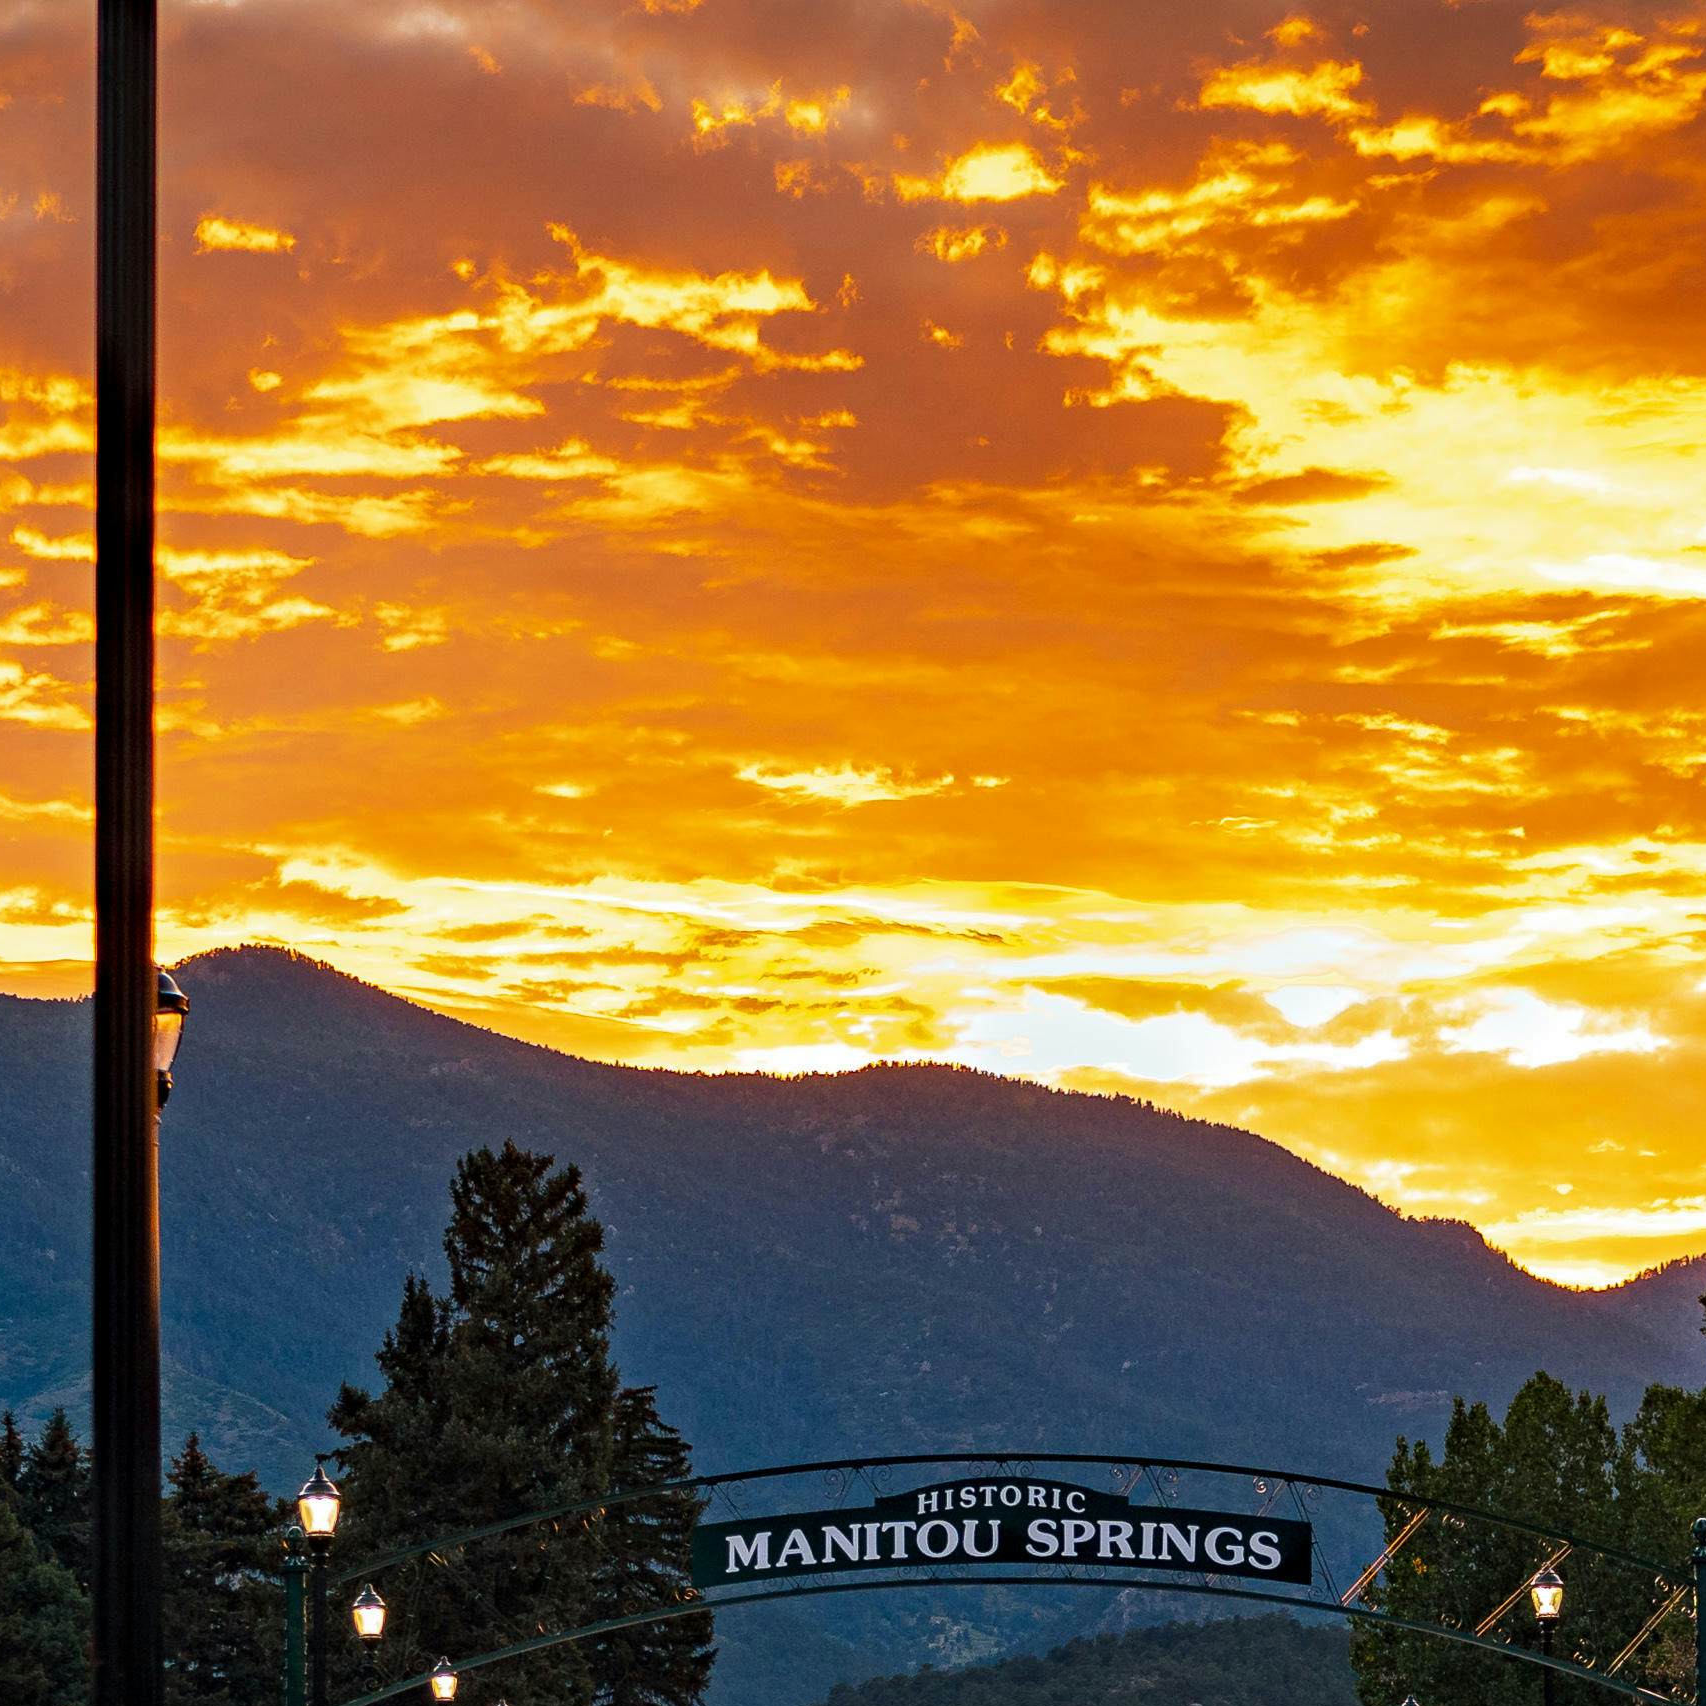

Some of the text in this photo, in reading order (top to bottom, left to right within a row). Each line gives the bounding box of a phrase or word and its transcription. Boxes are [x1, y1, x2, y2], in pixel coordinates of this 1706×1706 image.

[917, 1485, 1087, 1515] HISTORIC
[724, 1518, 1282, 1574] MANITOU SPRINGS
